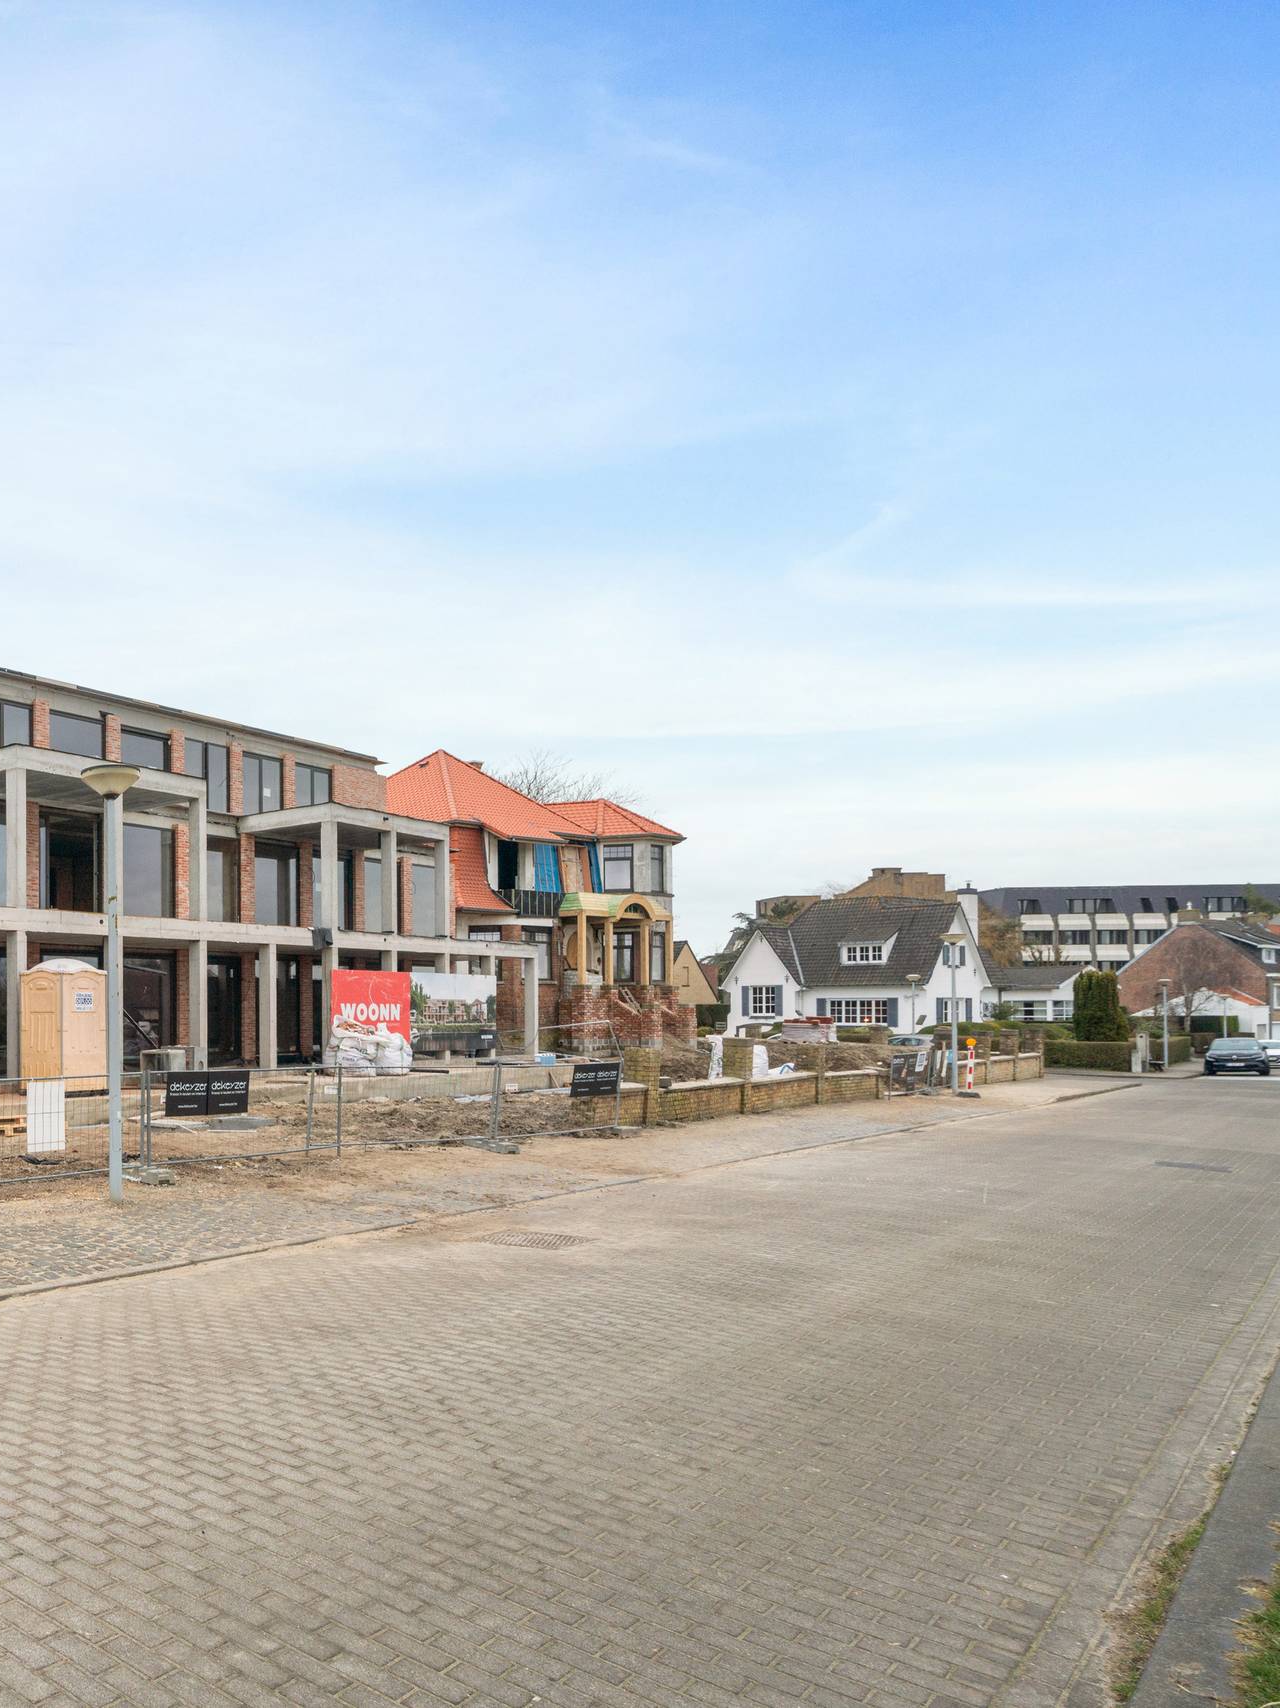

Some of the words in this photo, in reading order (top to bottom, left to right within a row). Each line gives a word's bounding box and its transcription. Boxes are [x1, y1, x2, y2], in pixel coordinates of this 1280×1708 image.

[340, 1002, 401, 1021] WOONN
[169, 1081, 207, 1092] dekeyzer
[211, 1080, 246, 1090] dekeyzer
